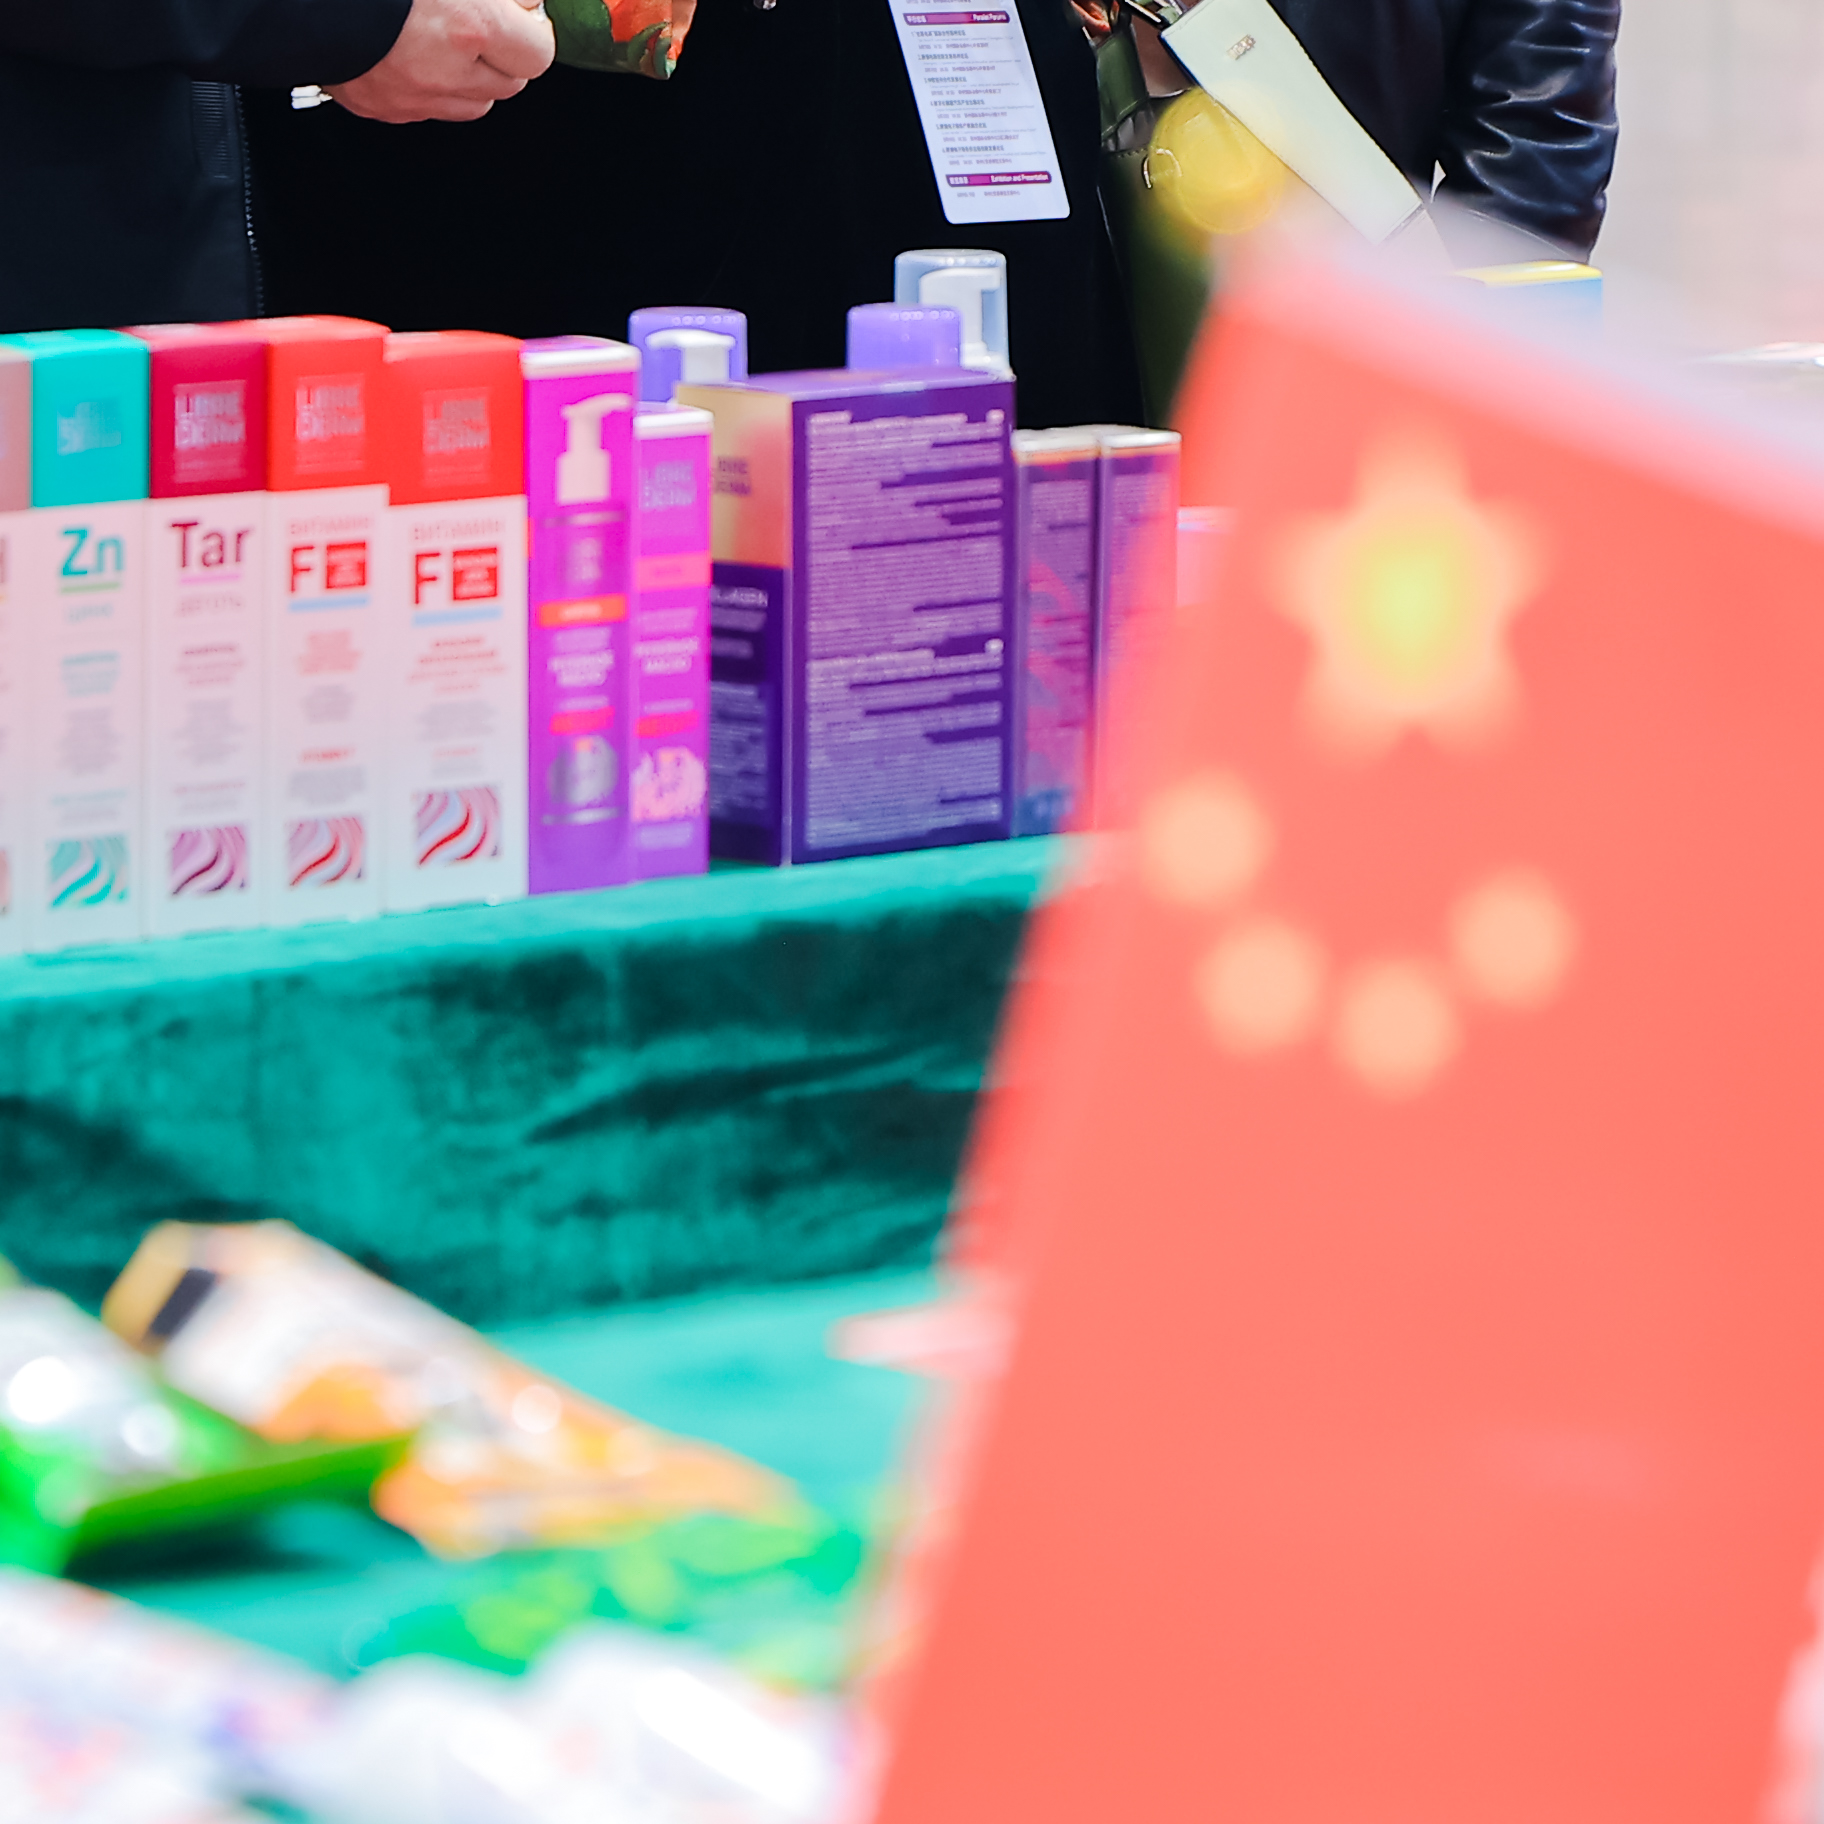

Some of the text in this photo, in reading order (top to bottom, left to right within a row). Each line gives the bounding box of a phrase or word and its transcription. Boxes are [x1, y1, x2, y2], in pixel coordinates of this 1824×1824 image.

[61, 528, 124, 576] Zn
[171, 521, 250, 569] Tar
[289, 545, 315, 593] F
[414, 551, 442, 605] F
